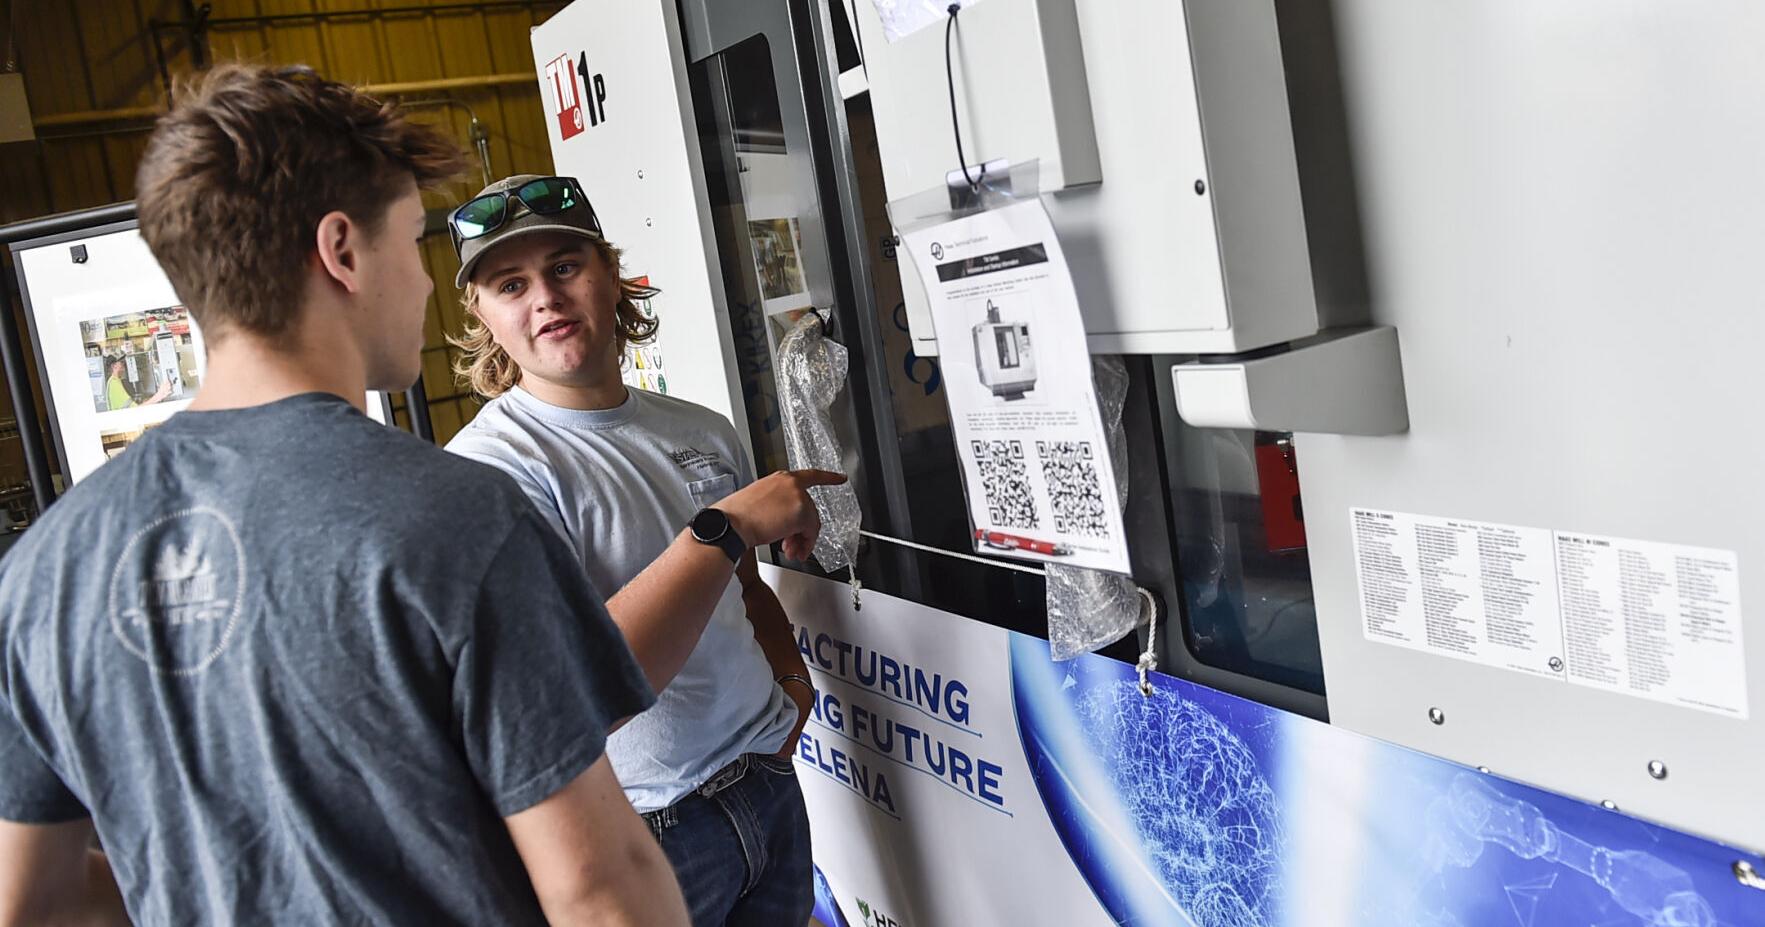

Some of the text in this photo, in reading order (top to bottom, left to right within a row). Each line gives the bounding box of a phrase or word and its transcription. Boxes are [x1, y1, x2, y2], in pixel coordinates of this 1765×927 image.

[545, 53, 577, 115] TM
[790, 624, 969, 725] ACTURING
[795, 731, 895, 813] ELENA
[851, 704, 1003, 806] FUTURE
